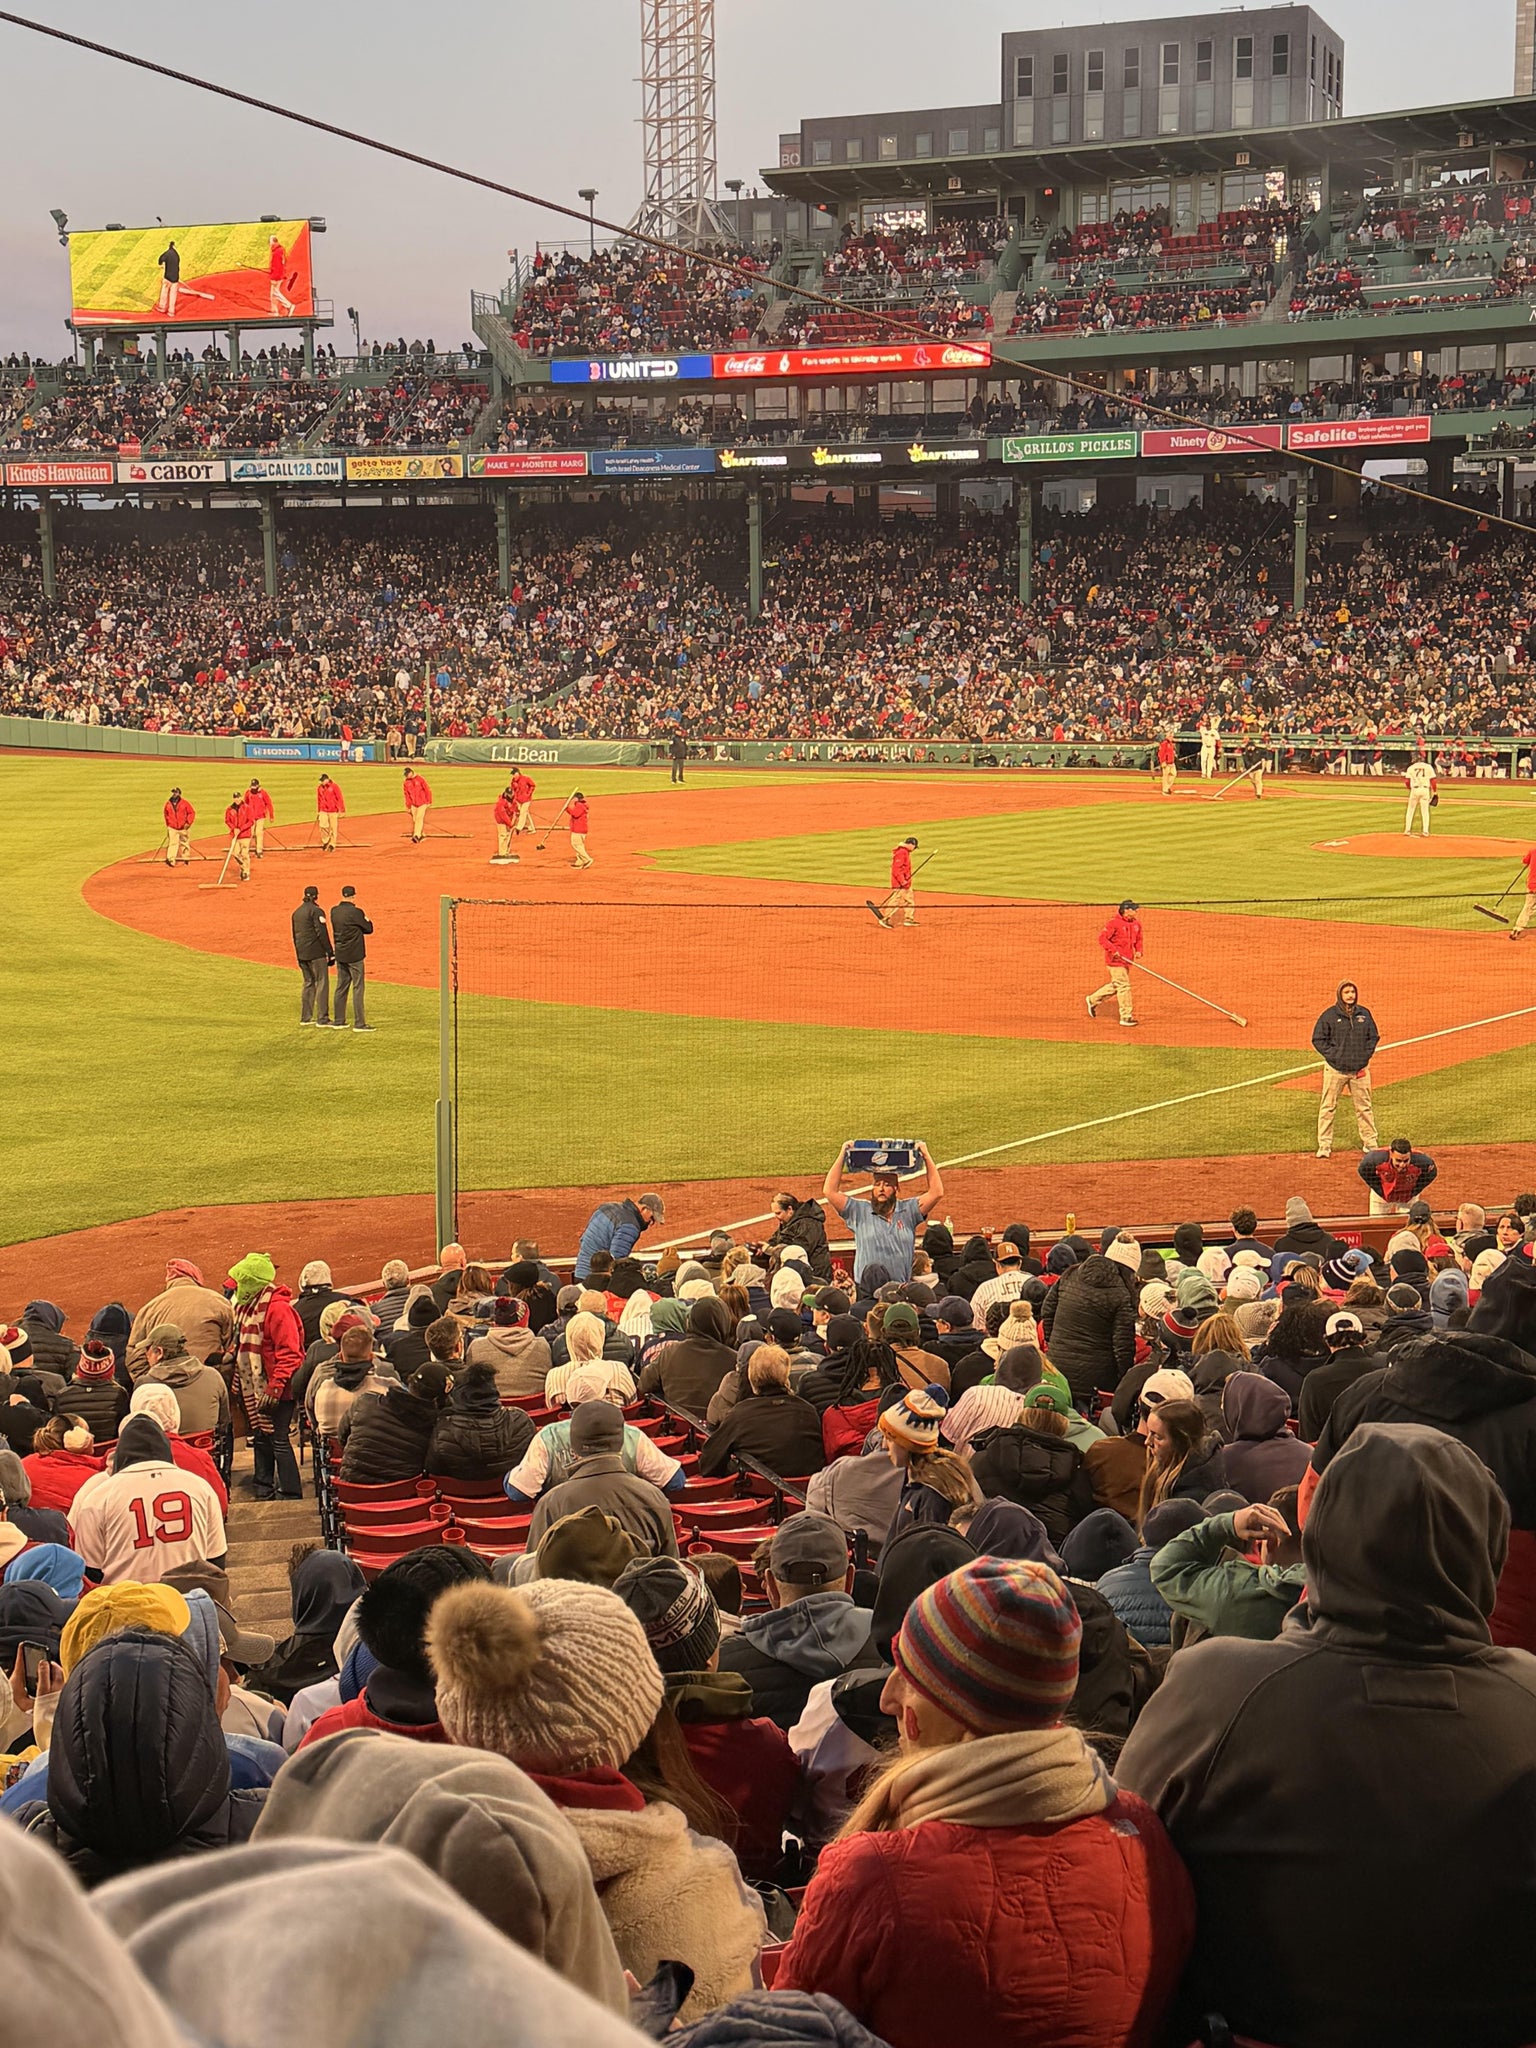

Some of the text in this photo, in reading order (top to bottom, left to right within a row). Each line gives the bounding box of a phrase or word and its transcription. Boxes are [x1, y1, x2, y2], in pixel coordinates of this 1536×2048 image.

[609, 360, 678, 379] UNITED
[1170, 436, 1206, 448] Ninety
[1292, 427, 1357, 444] Safelite
[1023, 439, 1132, 455] GRILLO'S PICKLES
[268, 462, 339, 476] CALL128.COM
[487, 461, 508, 470] MAKE
[522, 460, 558, 469] MONSTER
[560, 459, 584, 468] MARG
[682, 463, 700, 471] Center
[9, 465, 109, 483] King's Hawaiian
[262, 748, 302, 756] HONDA
[490, 746, 560, 763] L.L.Bean
[1414, 768, 1425, 778] 71
[129, 1490, 193, 1550] 19
